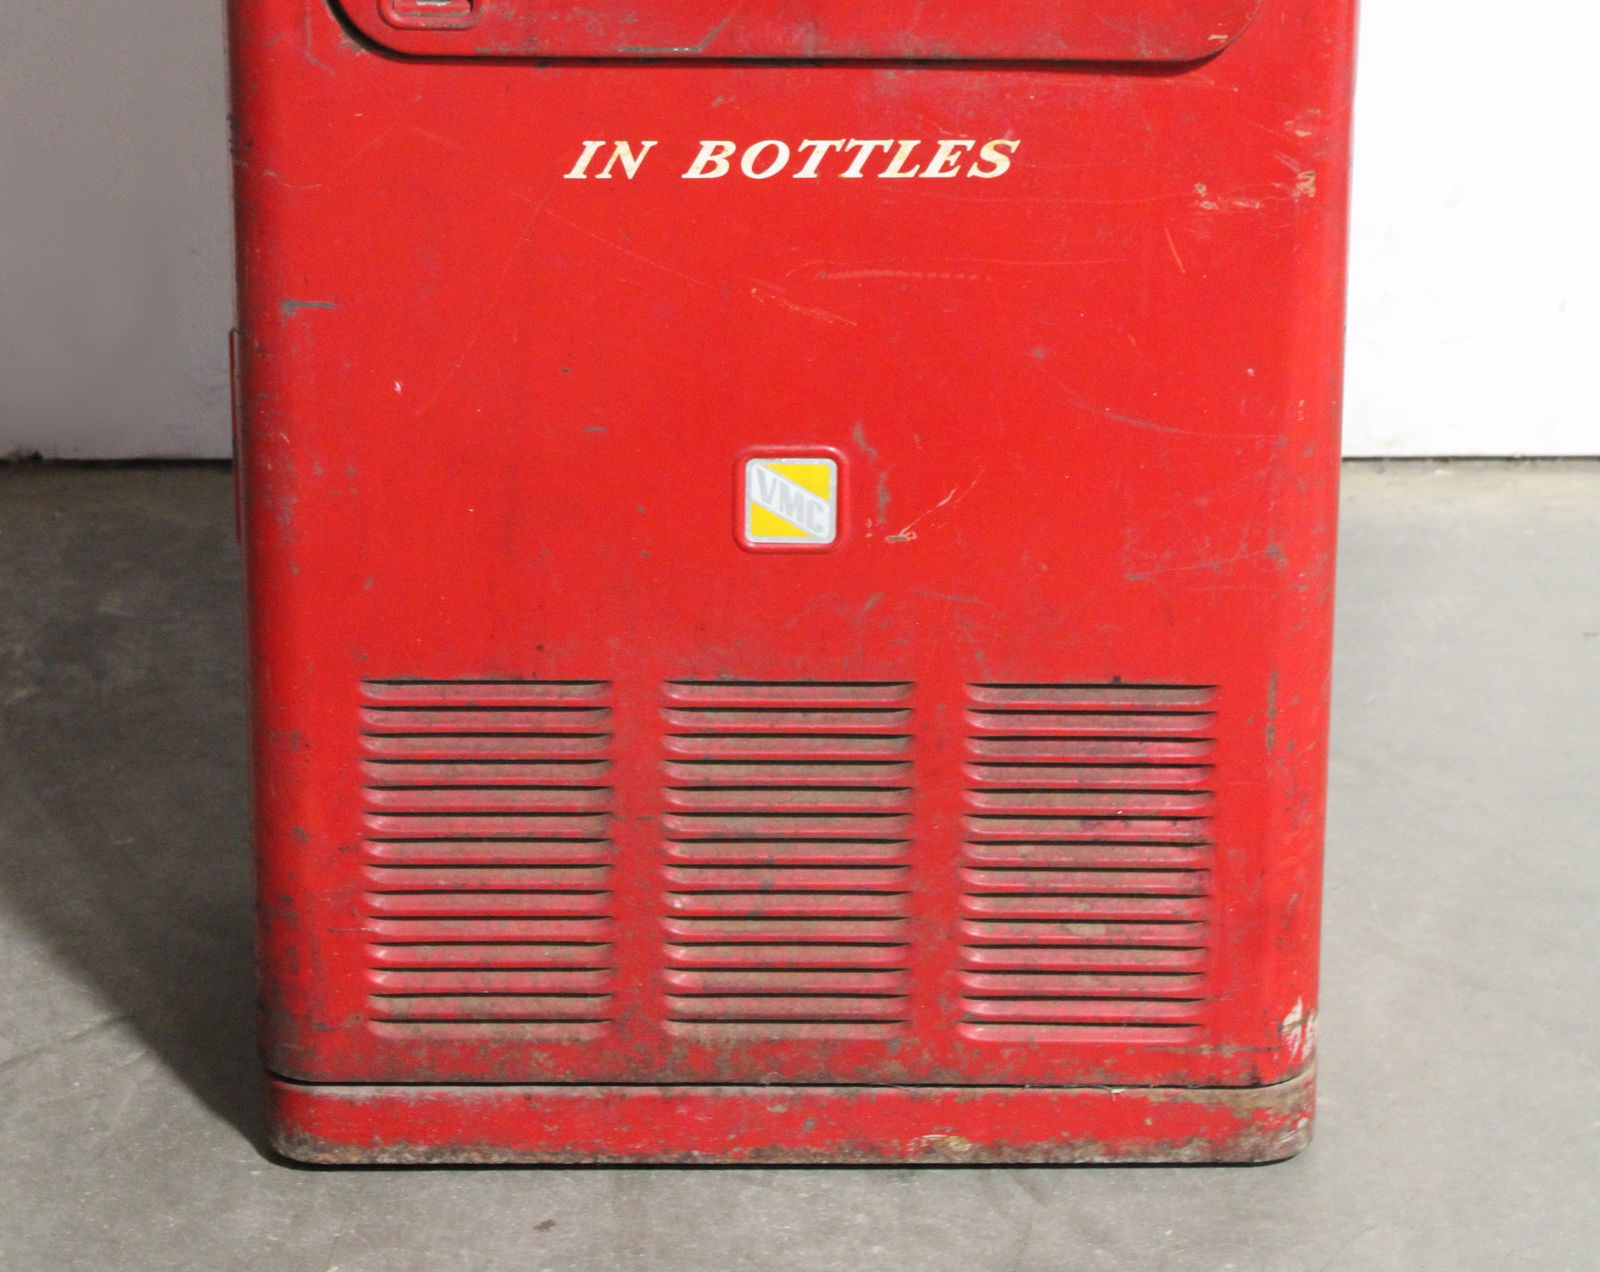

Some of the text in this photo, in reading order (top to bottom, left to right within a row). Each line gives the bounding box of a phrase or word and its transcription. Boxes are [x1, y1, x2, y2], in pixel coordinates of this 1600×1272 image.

[563, 138, 1021, 180] IN BOTTLES
[756, 468, 825, 534] VMC
